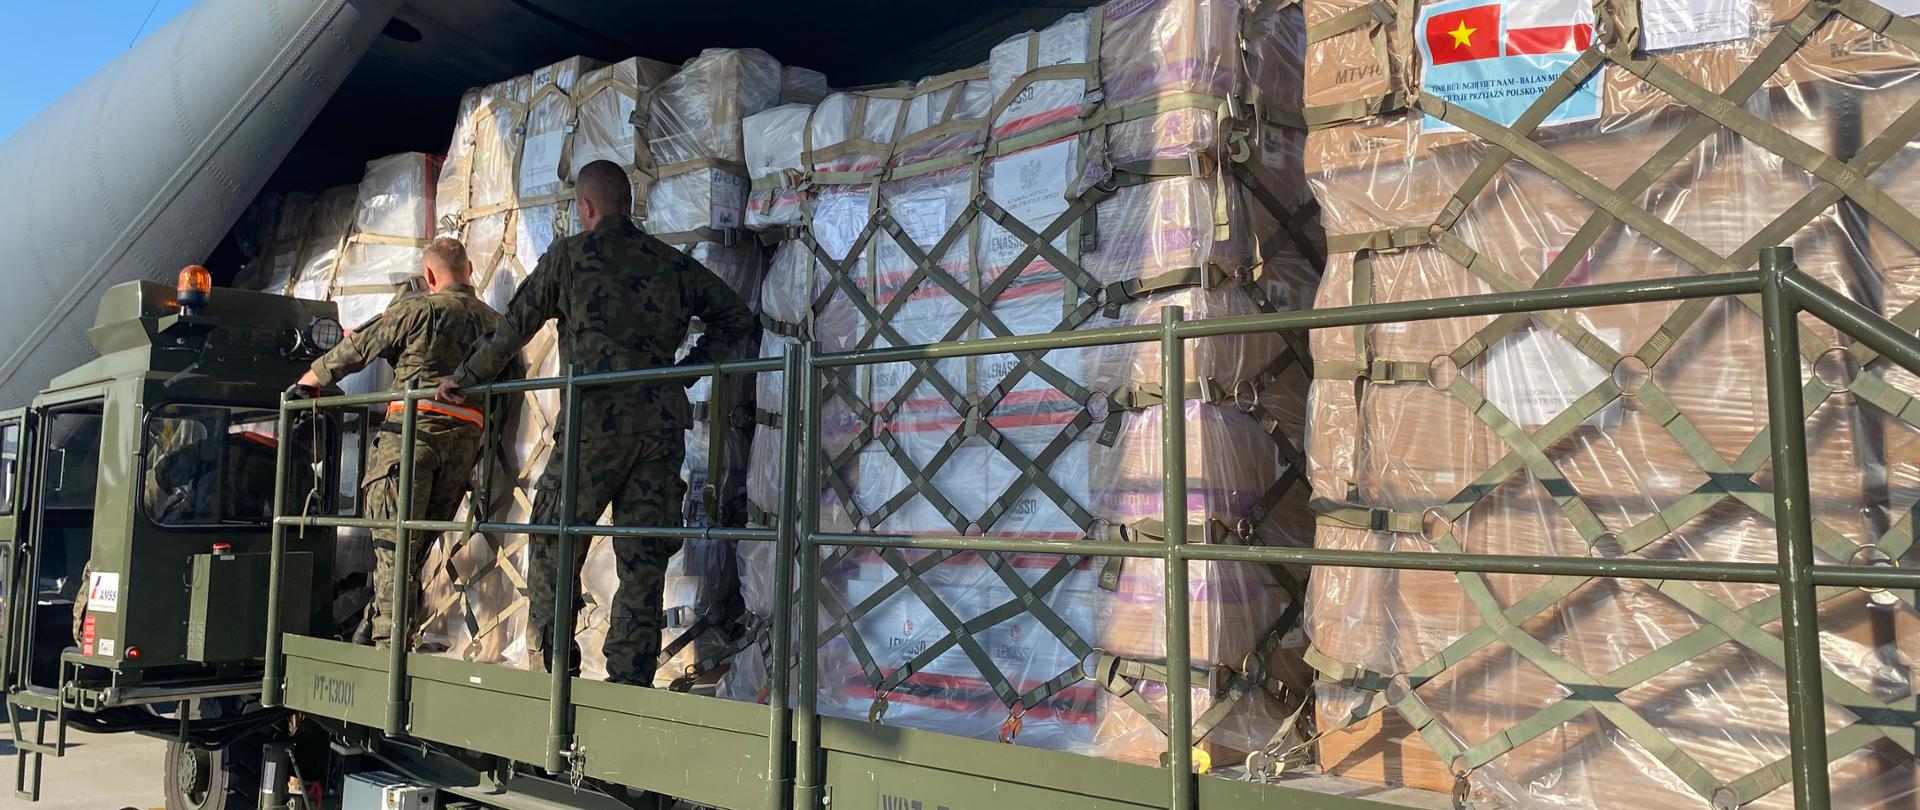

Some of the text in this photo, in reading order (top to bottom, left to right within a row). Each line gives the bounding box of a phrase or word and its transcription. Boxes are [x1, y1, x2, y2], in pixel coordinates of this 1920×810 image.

[1497, 77, 1515, 86] NAM
[1520, 76, 1530, 85] BA
[1531, 74, 1547, 83] LAN
[313, 674, 355, 708] PT-13001
